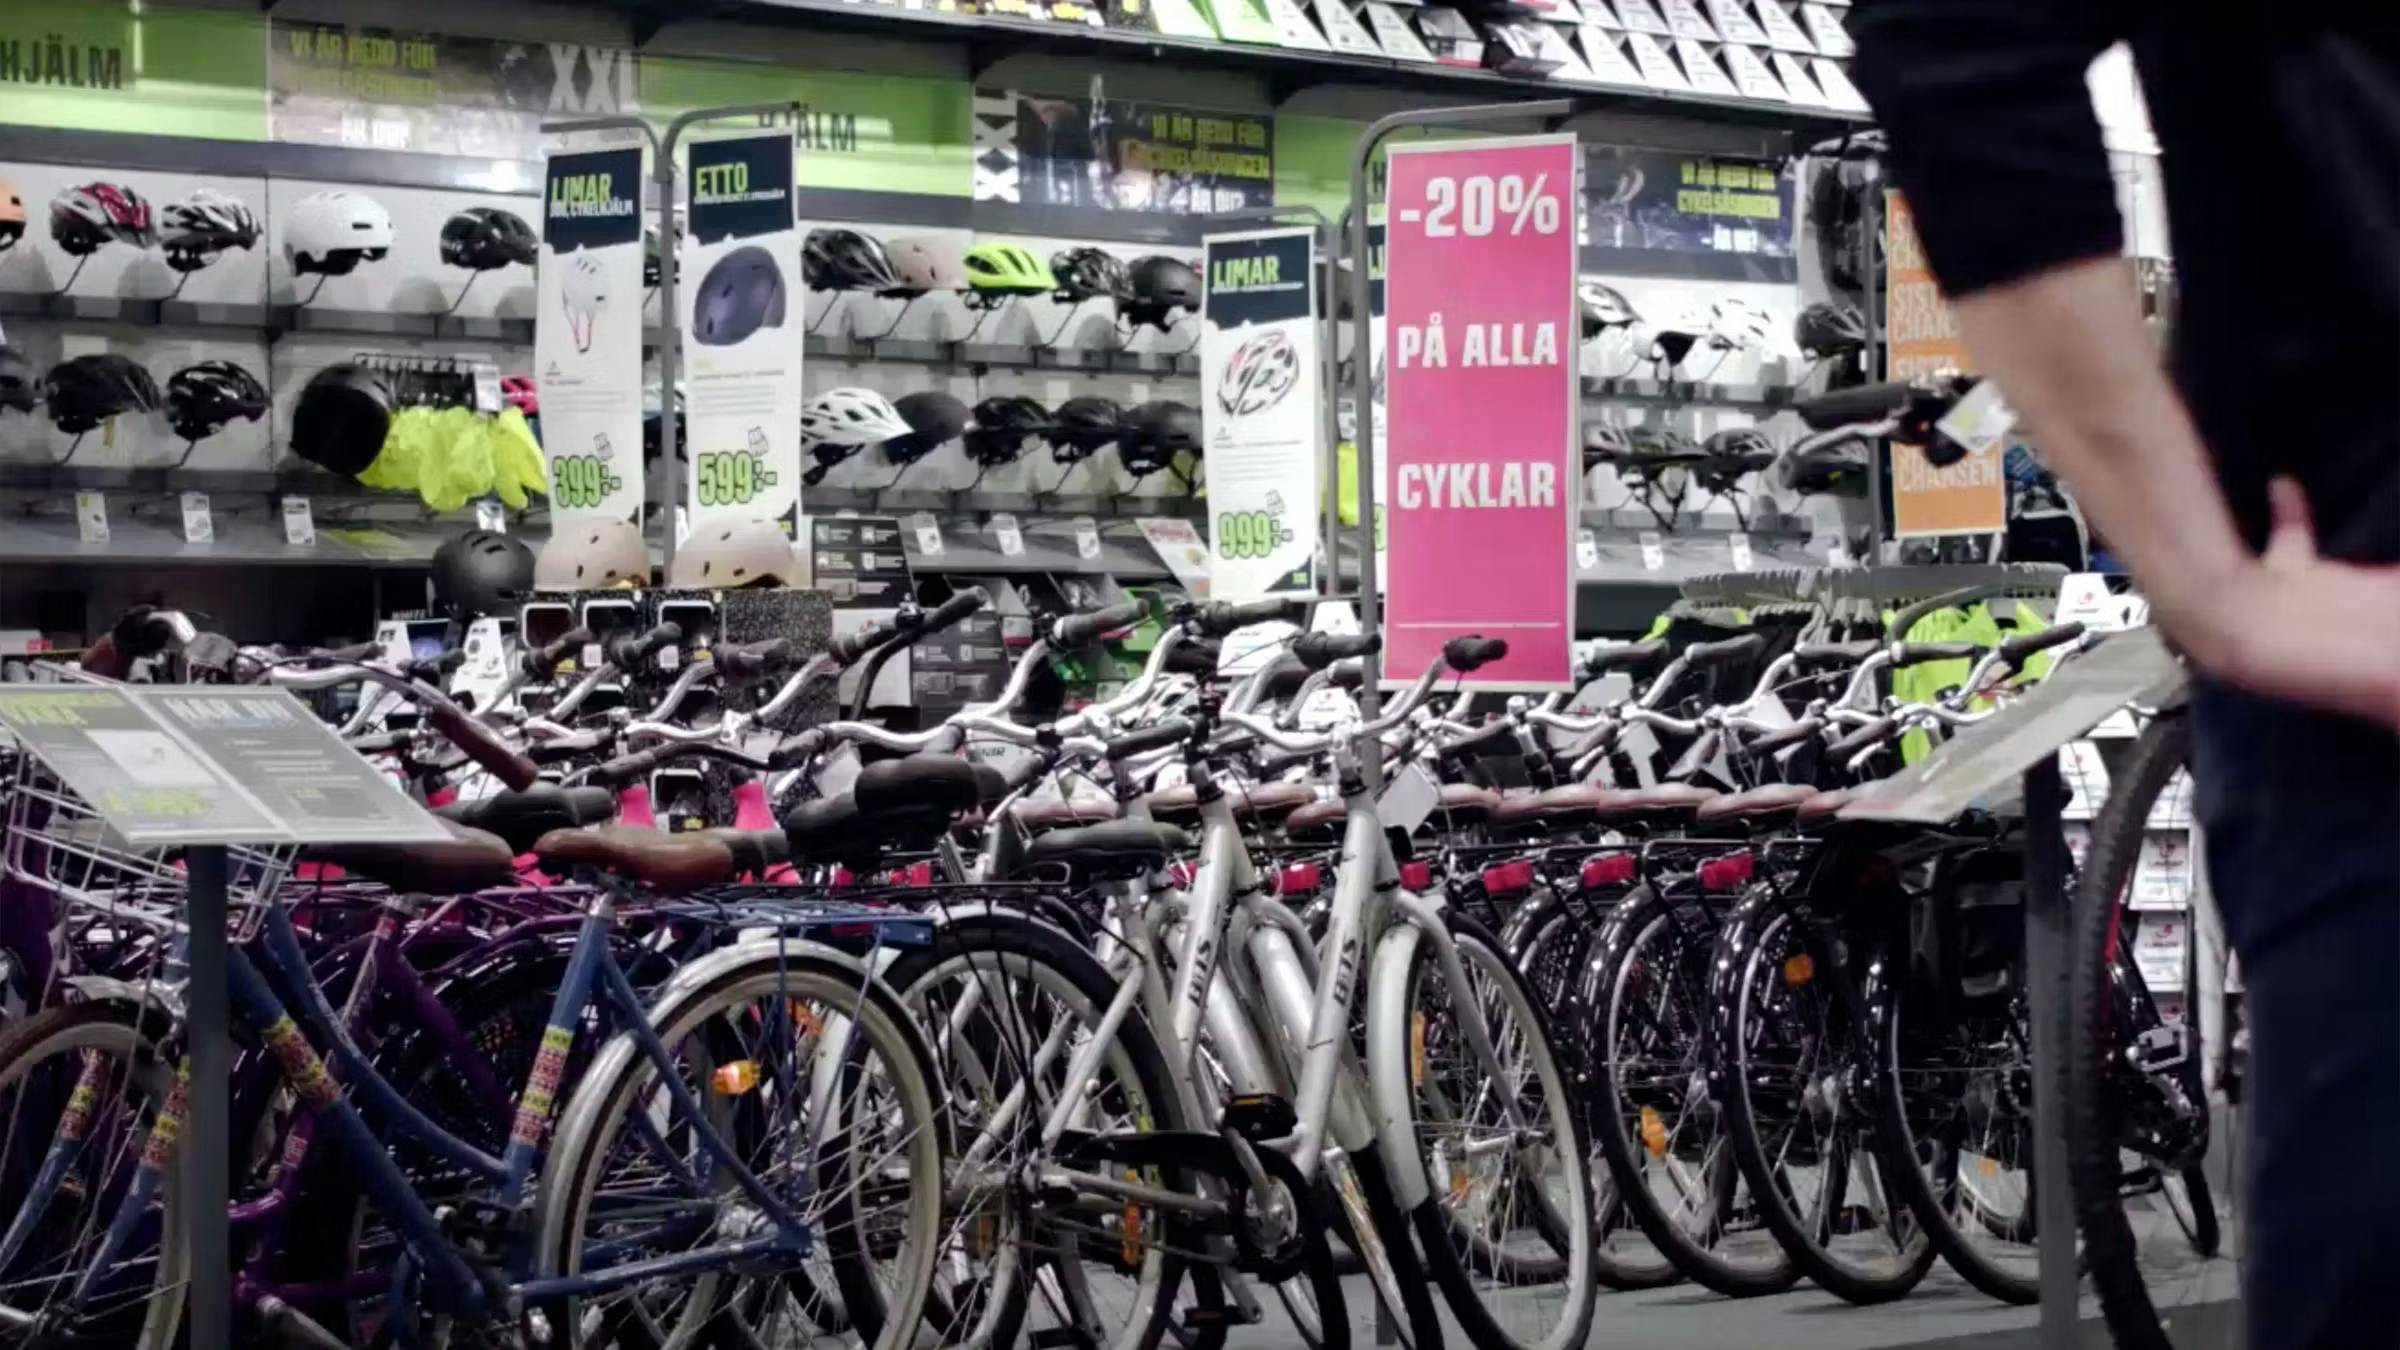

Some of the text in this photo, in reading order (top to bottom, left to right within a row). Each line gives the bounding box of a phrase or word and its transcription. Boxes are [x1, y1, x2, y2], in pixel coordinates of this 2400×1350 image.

[0, 33, 122, 90] HJÄLM
[316, 27, 343, 61] ÄR
[974, 88, 1021, 203] XXL
[551, 173, 611, 204] LIMAR
[695, 161, 749, 194] ETTO
[1399, 173, 1560, 237] -20%
[1213, 255, 1280, 289] LIMAR
[1397, 311, 1558, 369] PÅ ALLA
[552, 454, 623, 508] 399:-
[697, 449, 778, 507] 599:-
[1397, 461, 1557, 510] CYKLAR
[1218, 509, 1295, 560] 999:-
